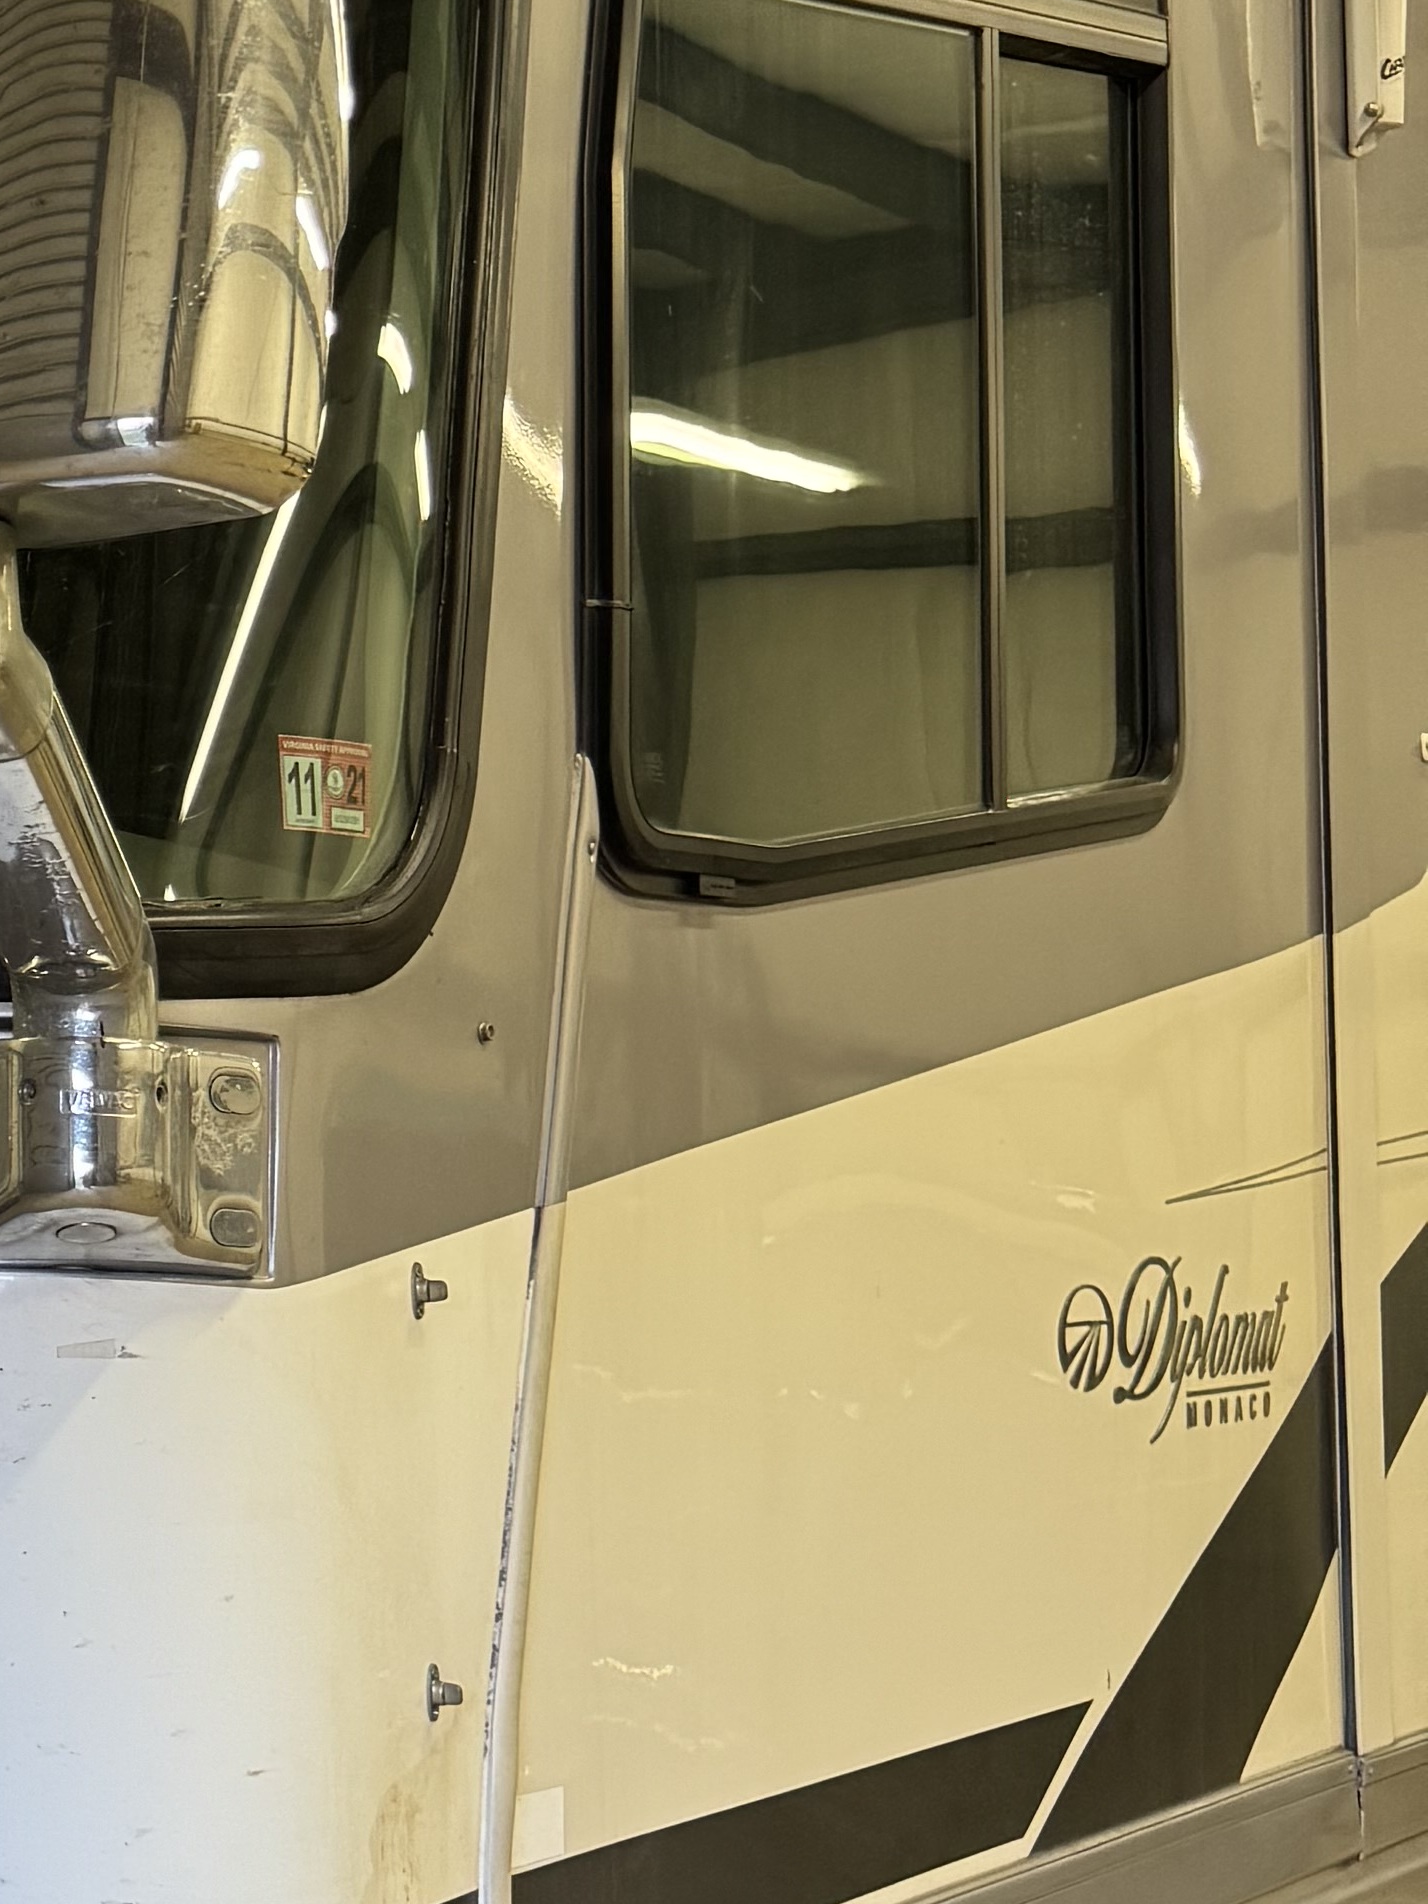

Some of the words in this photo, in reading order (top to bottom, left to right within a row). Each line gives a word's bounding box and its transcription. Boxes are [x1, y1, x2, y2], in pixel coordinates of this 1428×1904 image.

[288, 761, 317, 816] 11
[346, 765, 366, 806] 21
[1113, 1256, 1289, 1444] Diplomat
[1186, 1391, 1271, 1430] MONACO
